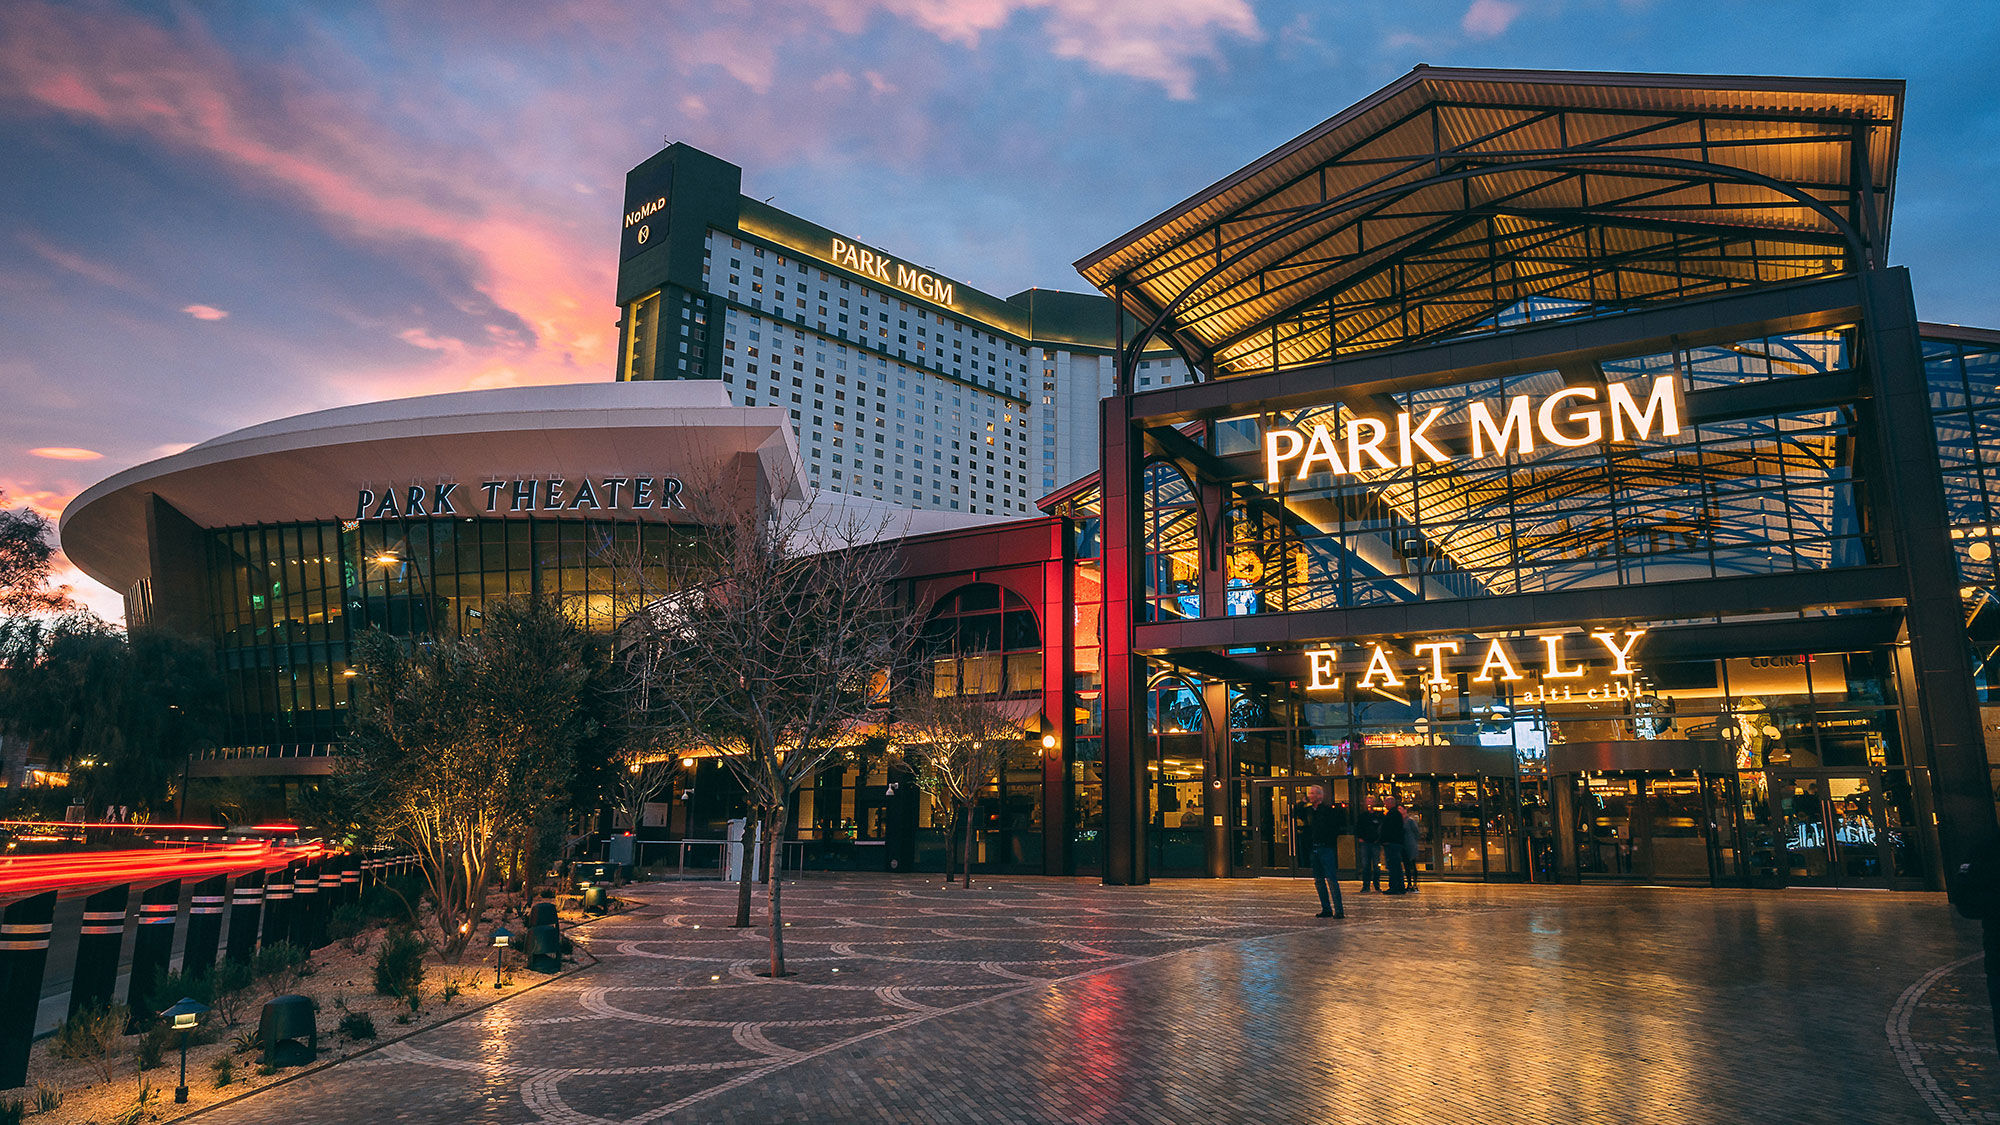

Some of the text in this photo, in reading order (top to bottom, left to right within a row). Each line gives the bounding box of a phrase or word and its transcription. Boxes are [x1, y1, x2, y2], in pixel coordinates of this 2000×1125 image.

[831, 238, 953, 305] PARK MGM
[1265, 375, 1681, 484] PARK MGM
[356, 477, 687, 520] PARK THEATER
[1304, 630, 1646, 691] EATALY
[1523, 682, 1643, 702] alti cibi
